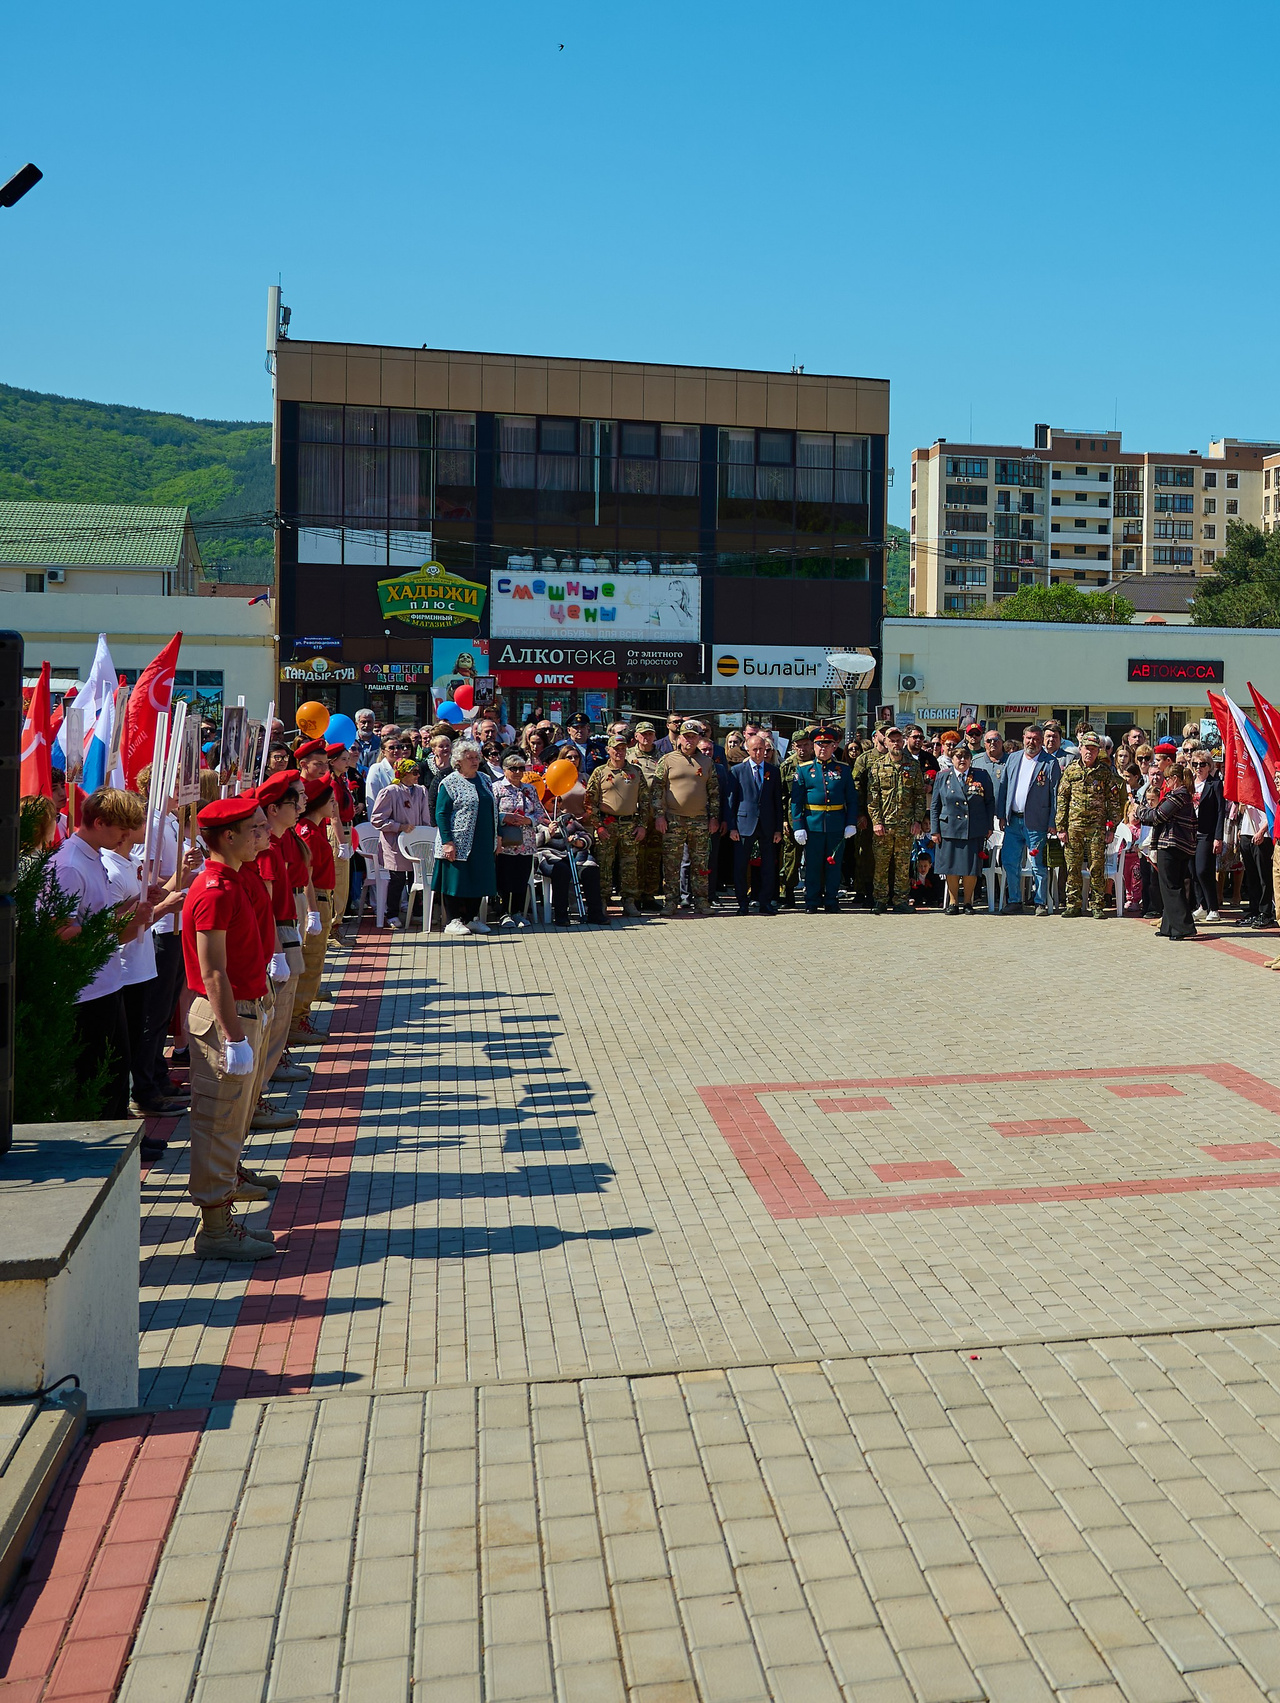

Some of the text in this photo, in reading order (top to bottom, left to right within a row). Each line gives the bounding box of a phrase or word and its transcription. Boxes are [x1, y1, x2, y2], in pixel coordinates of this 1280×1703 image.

[387, 585, 478, 605] ХАДЫЖИ
[410, 601, 455, 610] ПЛЮС
[410, 613, 453, 621] ФИРМЕННЫЙ
[411, 620, 453, 628] МАГАЗИН
[501, 628, 542, 637] ОДЕЖДА
[560, 630, 591, 638] ОБУВЬ
[620, 629, 644, 639] ВСЕЙ
[654, 632, 685, 640] СЕМЬИ
[498, 644, 683, 666] Алкотека От элитного
[640, 659, 679, 667] простого
[743, 658, 817, 676] Билайн
[285, 666, 355, 682] ТАНДЫР-ТУН
[364, 664, 430, 674] СМЕШНЫЕ
[1131, 664, 1216, 679] АВТОКАССА
[377, 674, 417, 683] ЦЕНЫ
[544, 674, 574, 684] МТС
[1004, 705, 1038, 714] ПРОДУКТЫ
